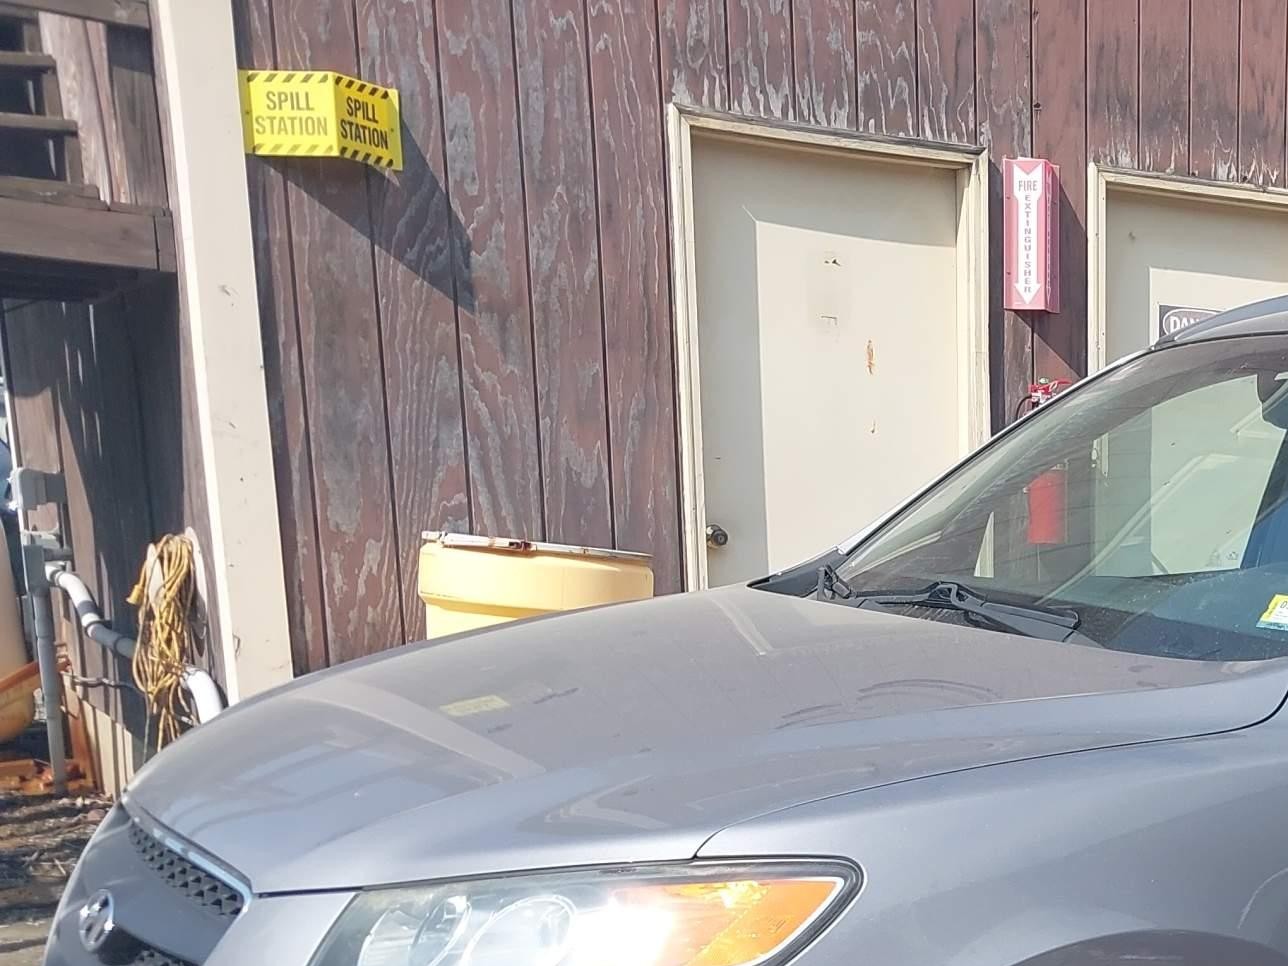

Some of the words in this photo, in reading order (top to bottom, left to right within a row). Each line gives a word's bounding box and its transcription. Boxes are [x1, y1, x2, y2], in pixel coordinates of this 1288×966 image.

[265, 90, 315, 112] SPILL
[346, 95, 379, 124] SPILL
[254, 116, 328, 137] STATION
[340, 119, 389, 150] STATION
[1018, 179, 1038, 192] FIRE
[1023, 193, 1033, 294] EXTINGUISHER
